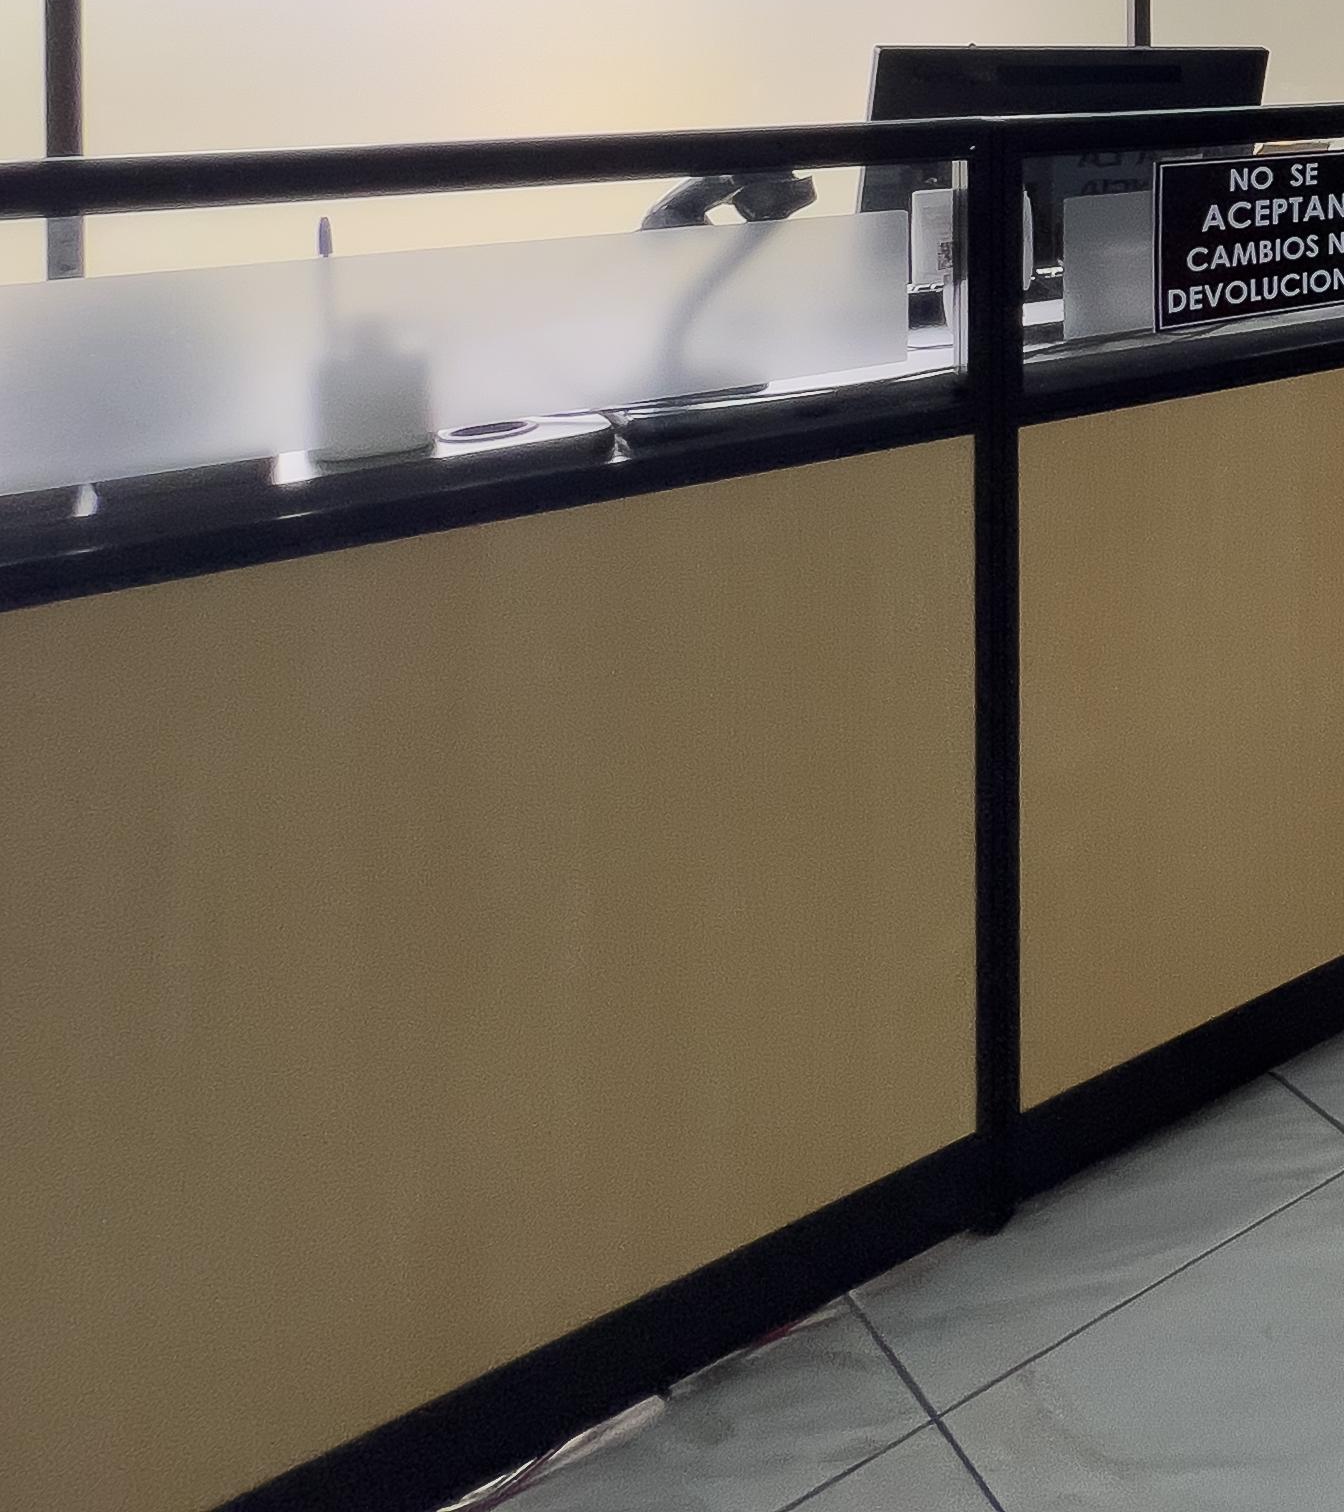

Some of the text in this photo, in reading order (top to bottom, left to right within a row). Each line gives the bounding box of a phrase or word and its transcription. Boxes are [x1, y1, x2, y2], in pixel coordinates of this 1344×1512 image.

[1229, 162, 1319, 192] NO SE
[1186, 234, 1319, 272] CAMBIOS
